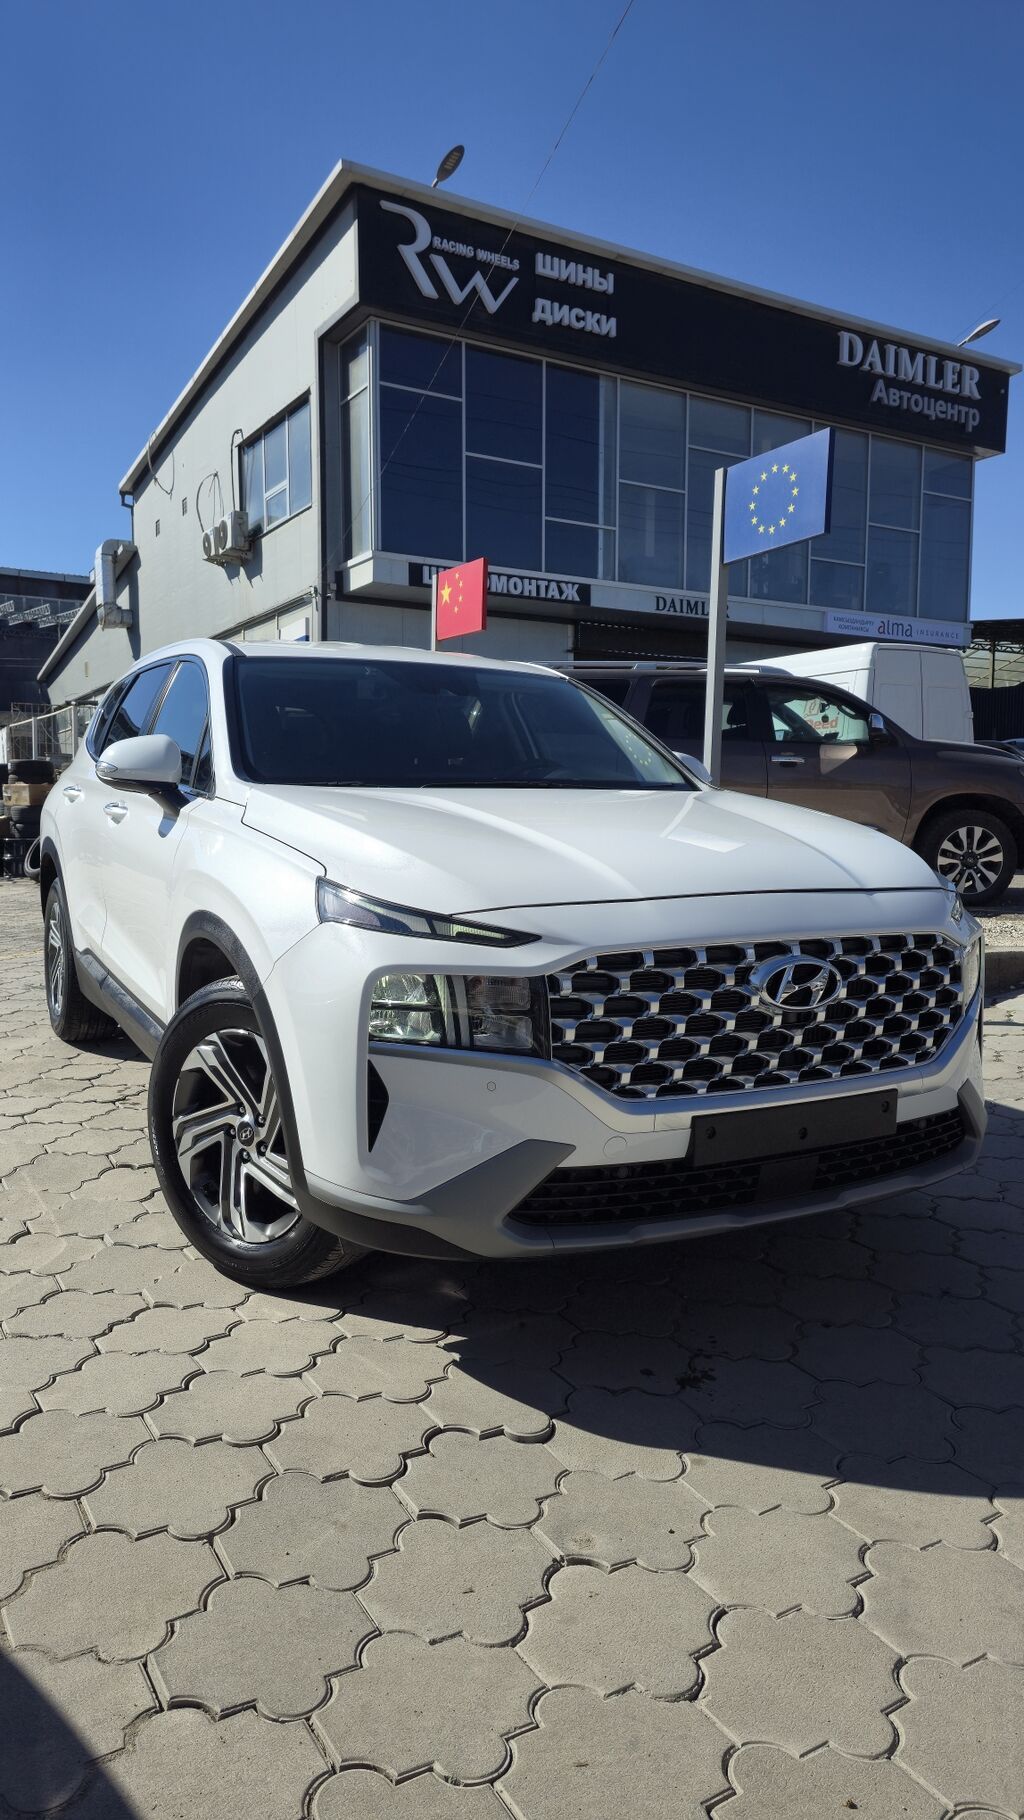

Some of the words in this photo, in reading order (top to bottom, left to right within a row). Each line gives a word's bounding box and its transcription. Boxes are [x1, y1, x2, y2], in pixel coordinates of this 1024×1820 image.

[432, 235, 475, 259] RACING
[476, 248, 520, 272] WHEELS
[535, 252, 615, 295] ШИНЫ
[531, 297, 617, 338] ДИСКИ
[837, 330, 982, 400] DAIMLER
[870, 378, 981, 433] Автоцентр
[422, 565, 581, 602] ШМОНТАЖ
[655, 595, 730, 619] DAIML
[877, 620, 913, 638] alma
[916, 629, 960, 640] INSURANCE
